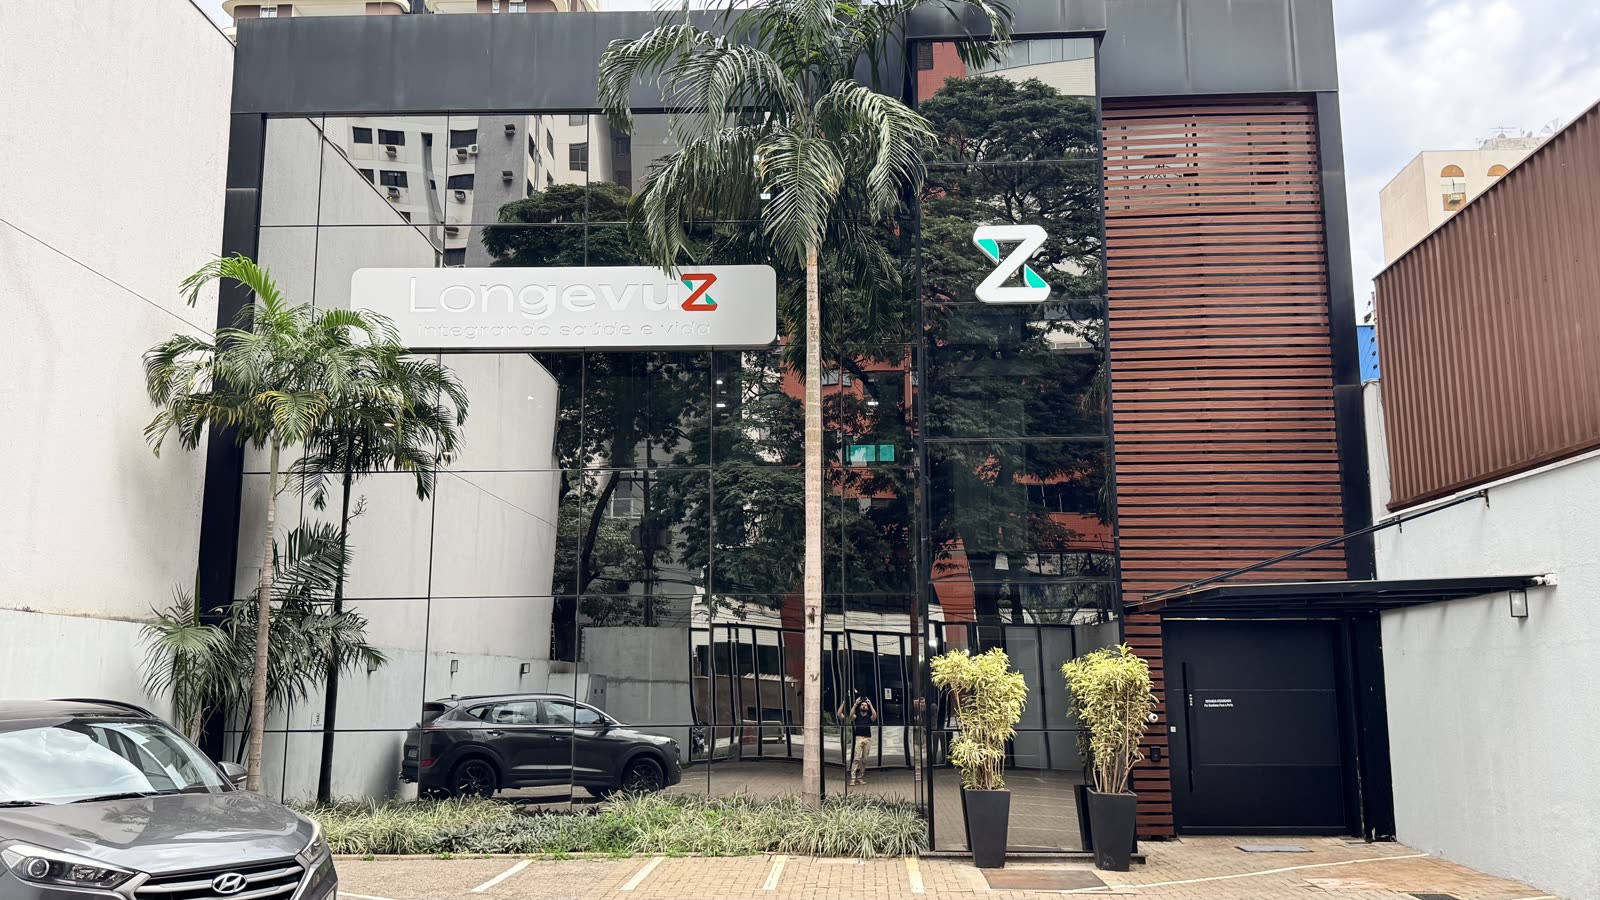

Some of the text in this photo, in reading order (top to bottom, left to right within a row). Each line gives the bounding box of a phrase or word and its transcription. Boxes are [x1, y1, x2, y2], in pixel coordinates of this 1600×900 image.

[973, 224, 1051, 304] Z
[559, 321, 632, 336] saúde
[640, 324, 653, 335] e
[660, 321, 711, 336] vida
